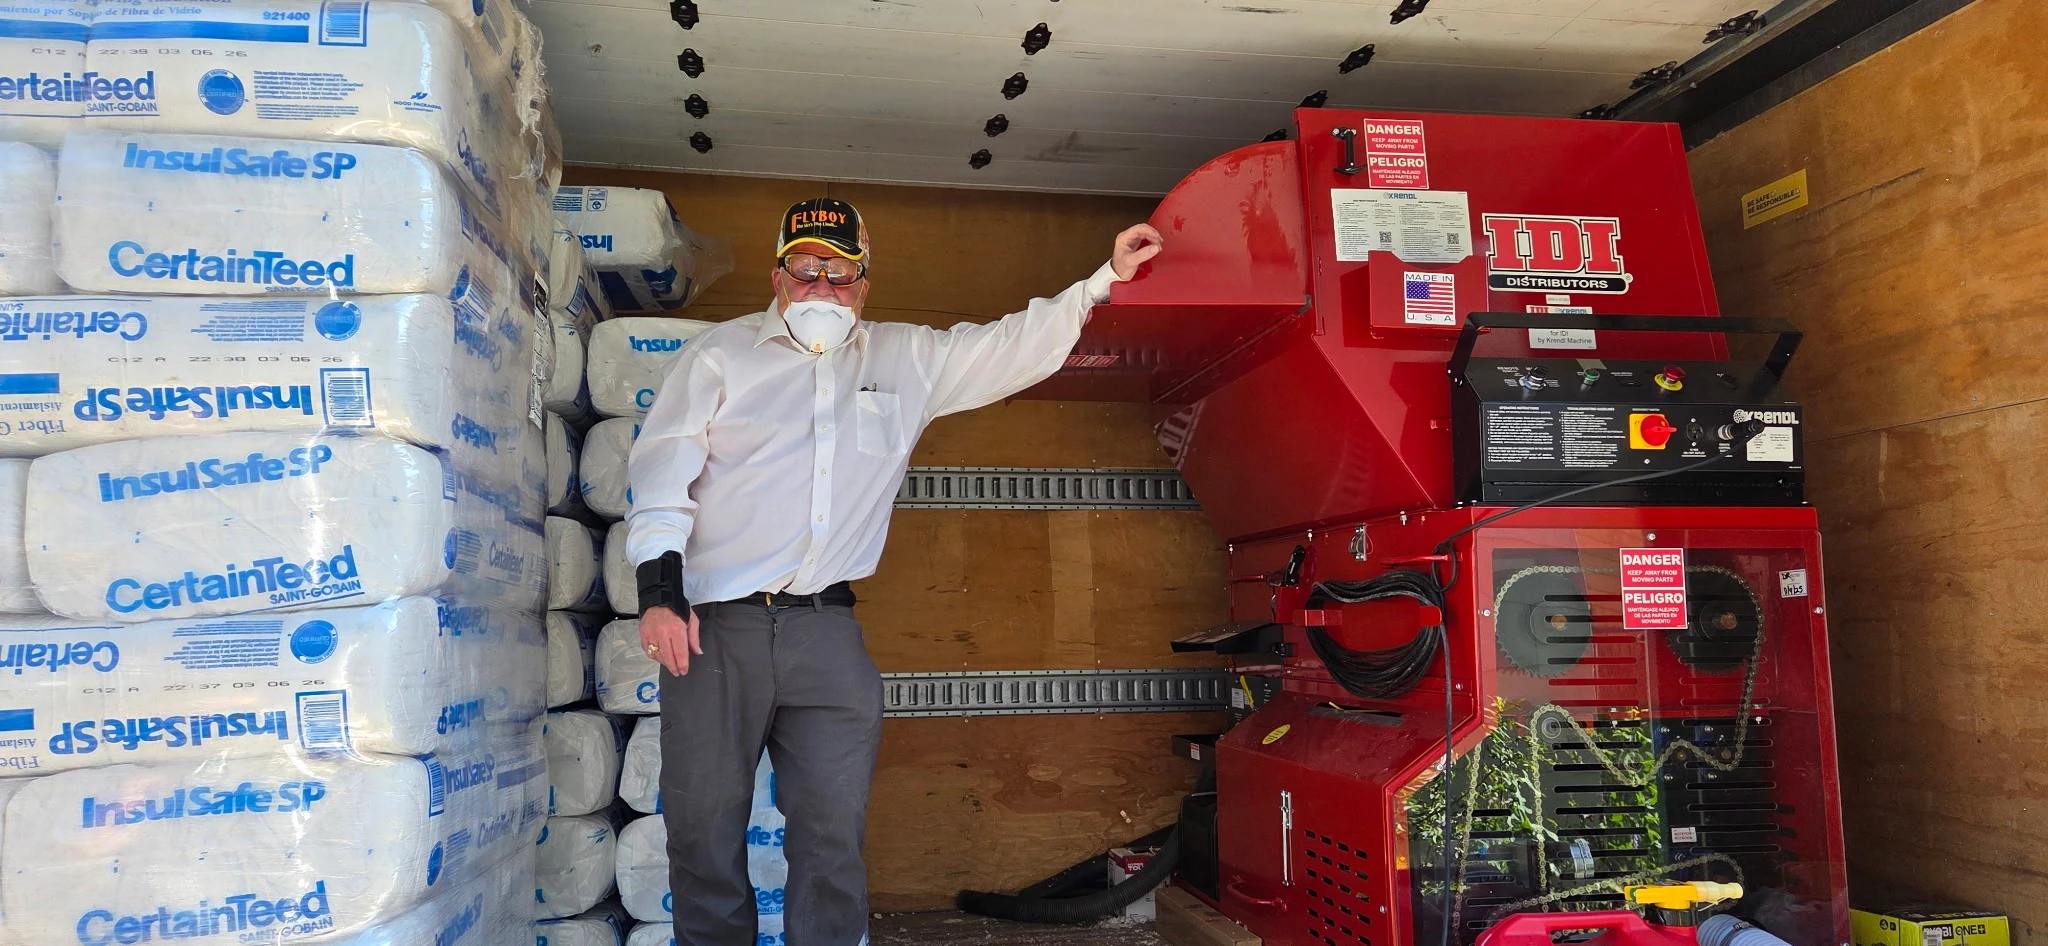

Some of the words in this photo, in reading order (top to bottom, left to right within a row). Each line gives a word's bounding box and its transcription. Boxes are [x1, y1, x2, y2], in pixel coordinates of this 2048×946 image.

[262, 12, 311, 21] 921400
[87, 102, 157, 112] SAINT-GOBAIN
[1366, 124, 1421, 135] DANGER
[122, 142, 308, 180] InsulSafe
[311, 150, 358, 181] SP
[1370, 157, 1424, 167] PELIGRO
[1756, 190, 1794, 210] RESPONSIBLE
[792, 210, 846, 233] FLYBOY
[1484, 215, 1623, 274] IDI
[108, 240, 354, 288] CertainTeed
[1506, 276, 1608, 289] DISTRIBUTORS
[74, 388, 121, 422] SP
[125, 384, 314, 420] InsulSafe
[18, 420, 66, 434] Fiber
[100, 452, 285, 503] InsulSafe
[288, 444, 333, 477] SP
[1622, 554, 1681, 566] DANGER
[105, 544, 359, 614] CertainTeed
[270, 580, 362, 604] SAINT-GOBAIN
[1624, 593, 1683, 604] PELIGRO
[48, 720, 97, 754] SP
[103, 710, 290, 751] InsulSafe
[82, 781, 273, 828] InsulSafe
[280, 780, 328, 813] SP
[76, 880, 330, 946] CertainTeed
